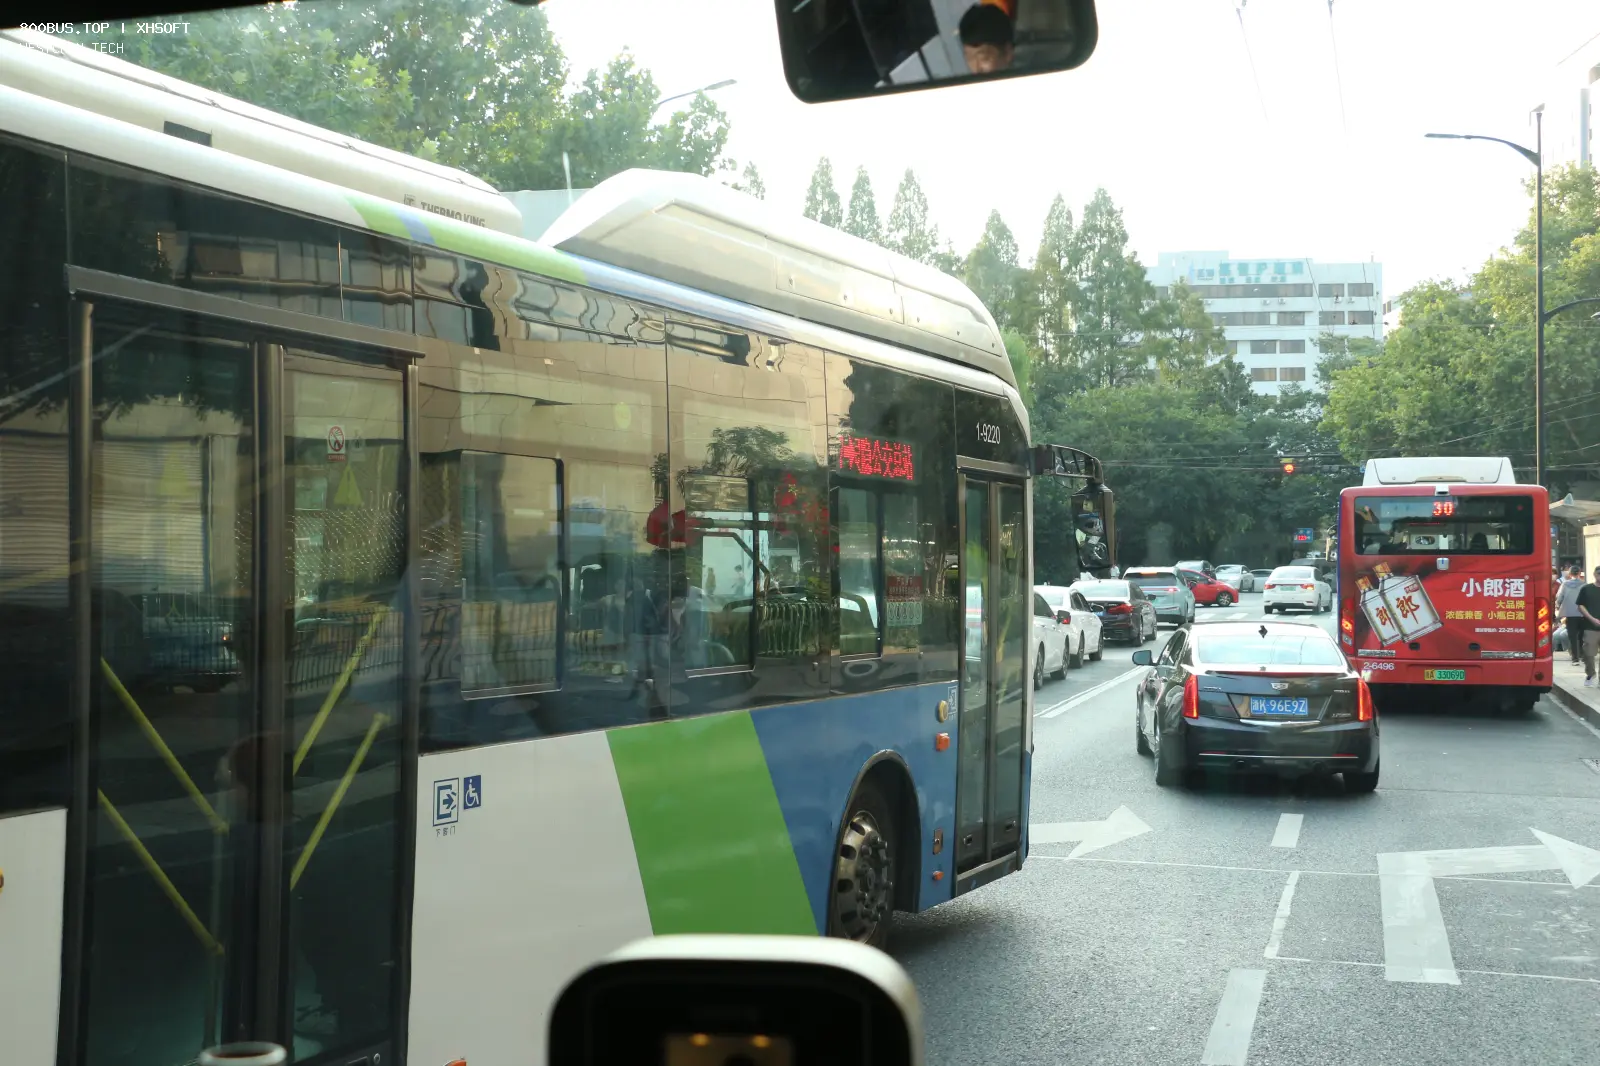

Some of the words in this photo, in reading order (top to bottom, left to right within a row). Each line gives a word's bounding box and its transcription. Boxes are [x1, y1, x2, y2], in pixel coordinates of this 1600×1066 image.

[976, 422, 1001, 445] 1-9220
[1432, 501, 1454, 517] 30
[1461, 577, 1525, 598] 小郎酒
[1496, 600, 1526, 610] 大品牌
[1363, 661, 1396, 671] 2-6496
